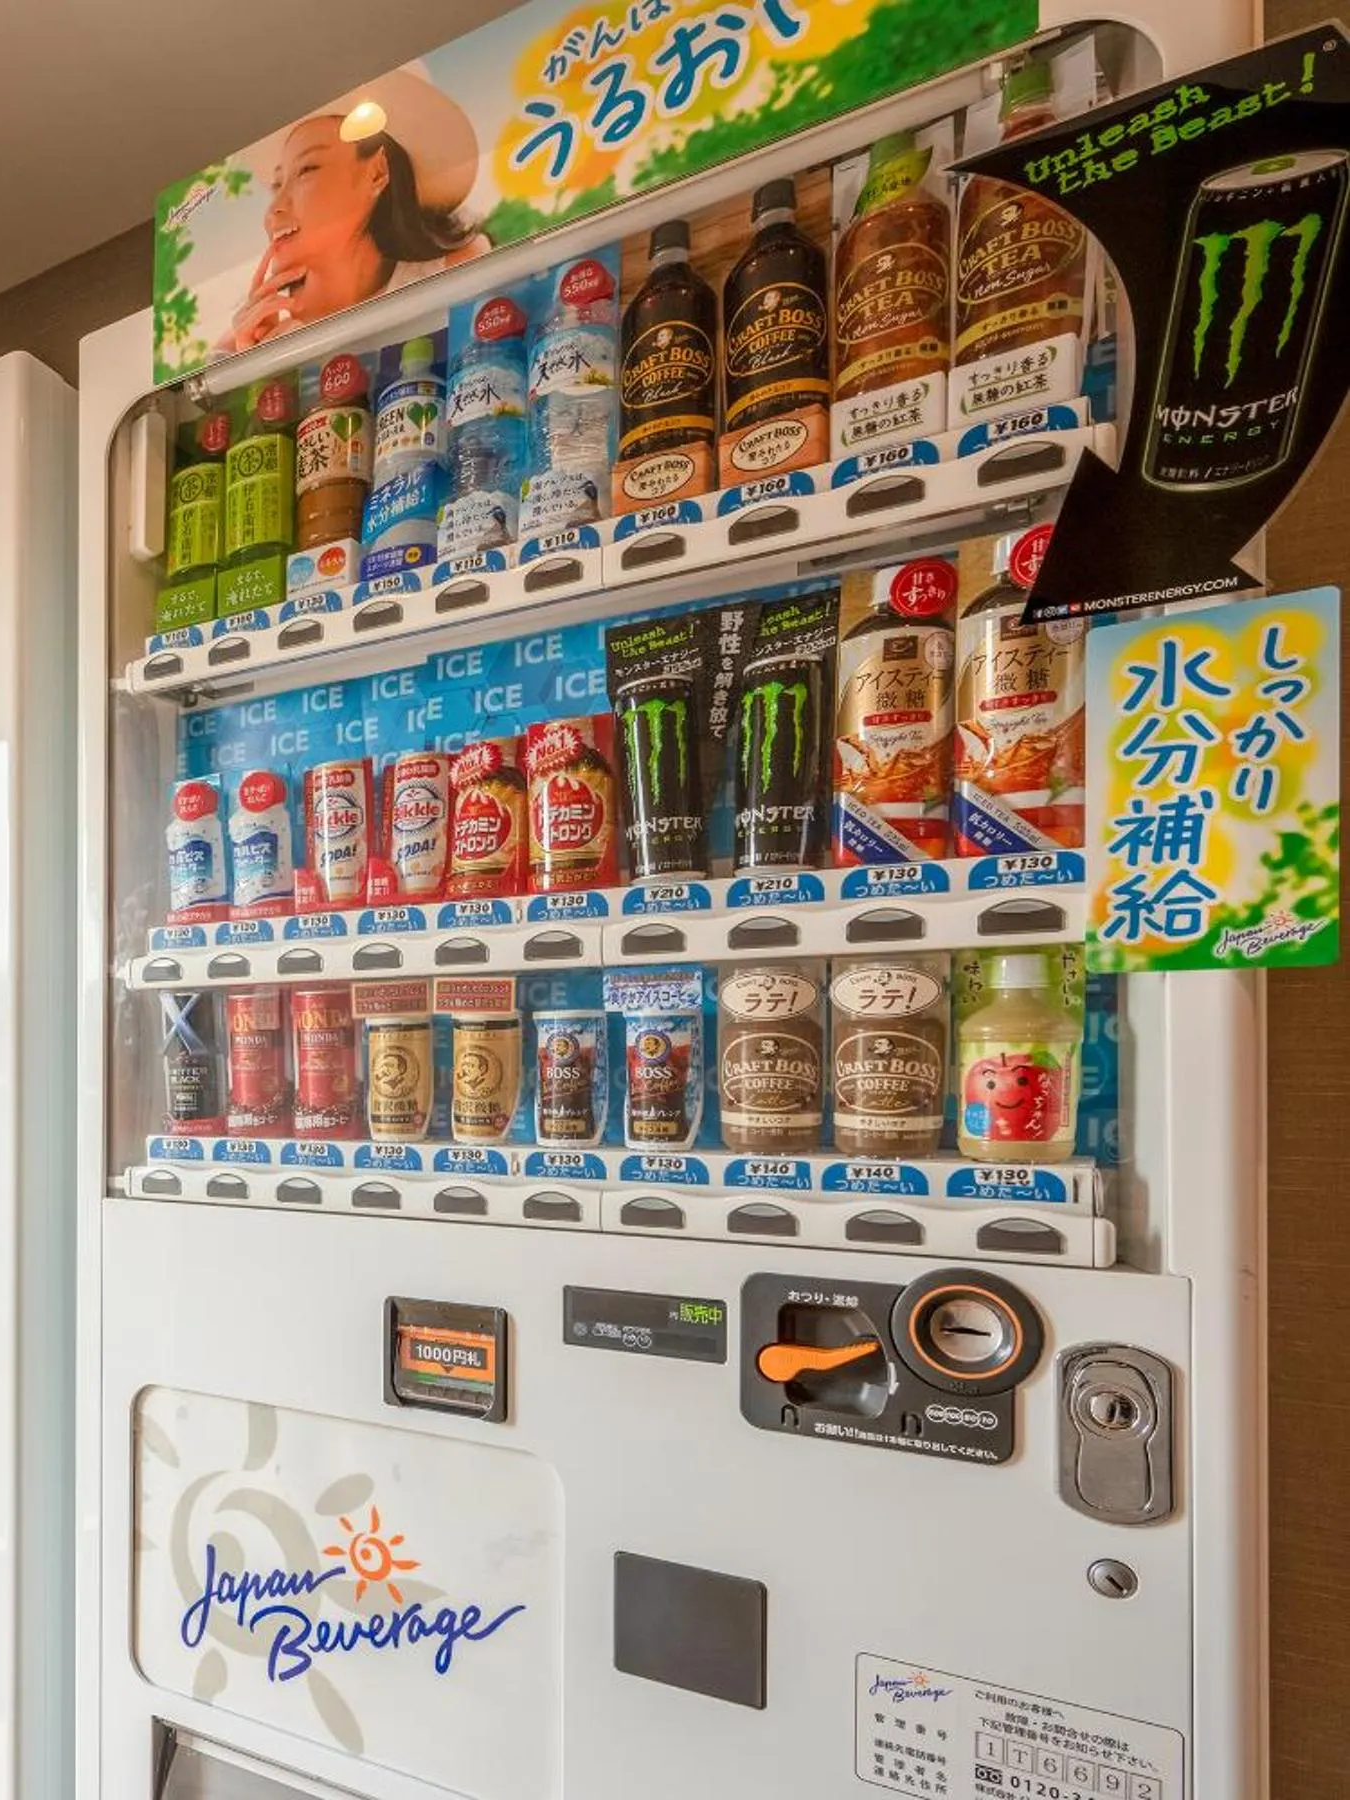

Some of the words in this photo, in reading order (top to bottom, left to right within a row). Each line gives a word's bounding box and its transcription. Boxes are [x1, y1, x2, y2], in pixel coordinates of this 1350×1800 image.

[1025, 85, 1210, 184] Unleash
[1058, 149, 1139, 195] the
[960, 229, 1019, 279] CRAFT
[1020, 219, 1080, 242] BOSS
[982, 244, 1043, 276] TEA
[838, 277, 892, 323] CRAFT
[895, 270, 946, 292] BOSS
[863, 290, 915, 318] TEA
[731, 314, 776, 351] CRAFT
[778, 306, 822, 329] BOSS
[749, 328, 796, 352] COFFEE
[623, 352, 666, 388] CRAFT
[669, 346, 711, 371] BOSS
[641, 366, 685, 389] COFFEE
[968, 347, 1050, 384] すっきり香る
[1154, 386, 1299, 430] MONSTER
[996, 413, 1043, 434] ¥160
[1162, 418, 1283, 446] ENERGY
[864, 448, 909, 468] ¥160
[369, 472, 422, 511] ミネラル
[746, 478, 786, 497] ¥160
[639, 505, 676, 523] ¥160
[544, 530, 576, 548] ¥110
[902, 584, 947, 608] すっきり
[1083, 575, 1240, 613] MONSTERENERGY.COM
[514, 631, 564, 668] ICE
[974, 646, 1071, 676] アイスティー
[436, 650, 484, 682] ICE
[371, 672, 416, 702] ICE
[856, 667, 948, 693] アイスティー
[302, 685, 344, 714] ICE
[474, 683, 524, 714] ICE
[240, 699, 278, 729] ICE
[1235, 626, 1305, 812] しっかり
[336, 716, 380, 746] ICE
[210, 741, 246, 766] ICE
[271, 730, 310, 757] ICE
[1103, 640, 1233, 941] 水分補給
[735, 805, 815, 829] MONSTER
[872, 866, 918, 880] ¥130
[1004, 855, 1054, 870] ¥130
[651, 886, 685, 900] ¥210
[756, 877, 794, 892] ¥210
[459, 903, 491, 915] ¥130
[551, 895, 585, 907] ¥130
[744, 990, 800, 1014] ラテ!
[858, 986, 918, 1010] ラテ!
[547, 1066, 581, 1079] BOSS
[636, 1066, 673, 1079] BOSS
[724, 1059, 774, 1077] CRAFT
[775, 1058, 818, 1078] BOSS
[836, 1060, 888, 1078] CRAFT
[889, 1058, 938, 1080] BOSS
[744, 1078, 795, 1091] COFFEE
[856, 1078, 910, 1093] COFFEE
[451, 1150, 482, 1161] ¥130
[548, 1154, 581, 1166] ¥130
[645, 1157, 683, 1170] ¥130
[750, 1163, 790, 1175] ¥140
[852, 1166, 895, 1179] ¥140
[981, 1169, 1029, 1181] ¥130
[678, 1303, 724, 1325] 販売中
[414, 1343, 482, 1369] 1000円札
[181, 1543, 347, 1649] Japan
[249, 1602, 527, 1684] Beverage
[868, 1674, 914, 1697] Japan
[891, 1687, 954, 1703] Beverage
[975, 1689, 1066, 1720] ご利用のお客様へ
